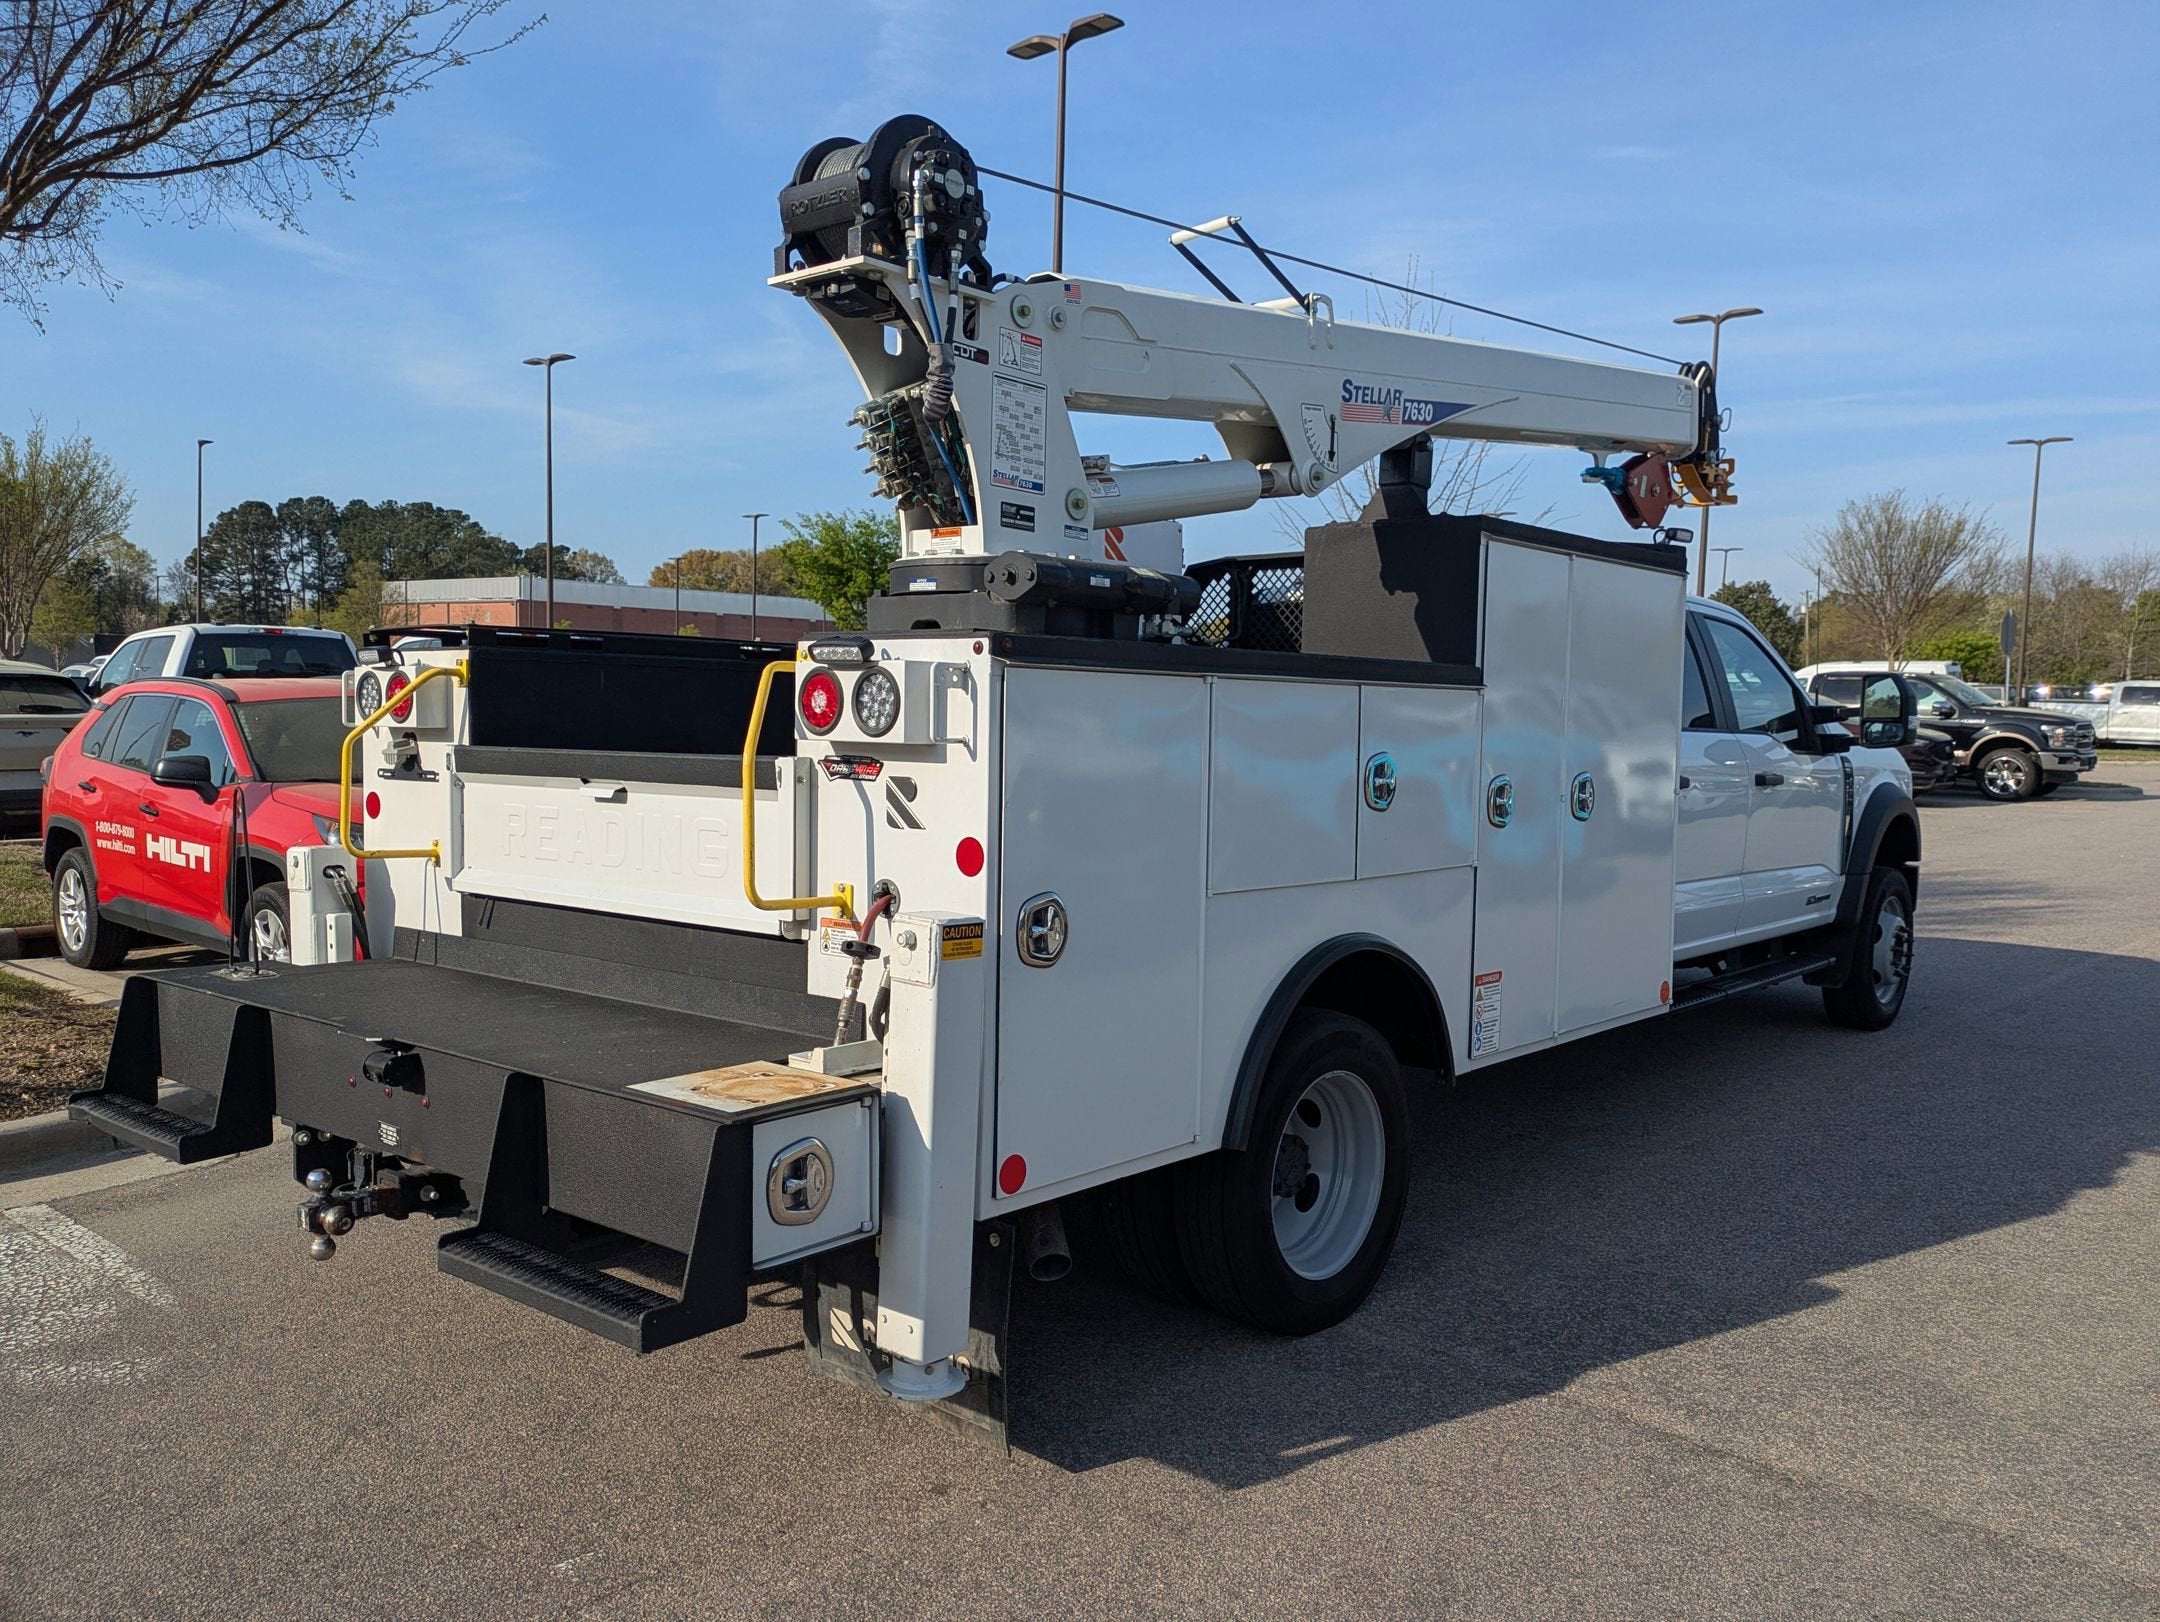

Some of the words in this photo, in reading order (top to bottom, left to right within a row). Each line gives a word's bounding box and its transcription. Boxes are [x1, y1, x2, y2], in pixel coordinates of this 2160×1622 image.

[790, 186, 848, 217] ROTZLER
[952, 343, 977, 359] CDT
[1341, 378, 1402, 406] STELLAR
[1404, 402, 1433, 421] 7630
[993, 469, 1019, 481] STELLAR
[95, 821, 135, 839] 1-800-879-8000
[96, 838, 136, 855] www.hilti.com
[502, 803, 729, 879] READING
[146, 833, 211, 873] HILTI
[943, 925, 982, 939] CAUTION
